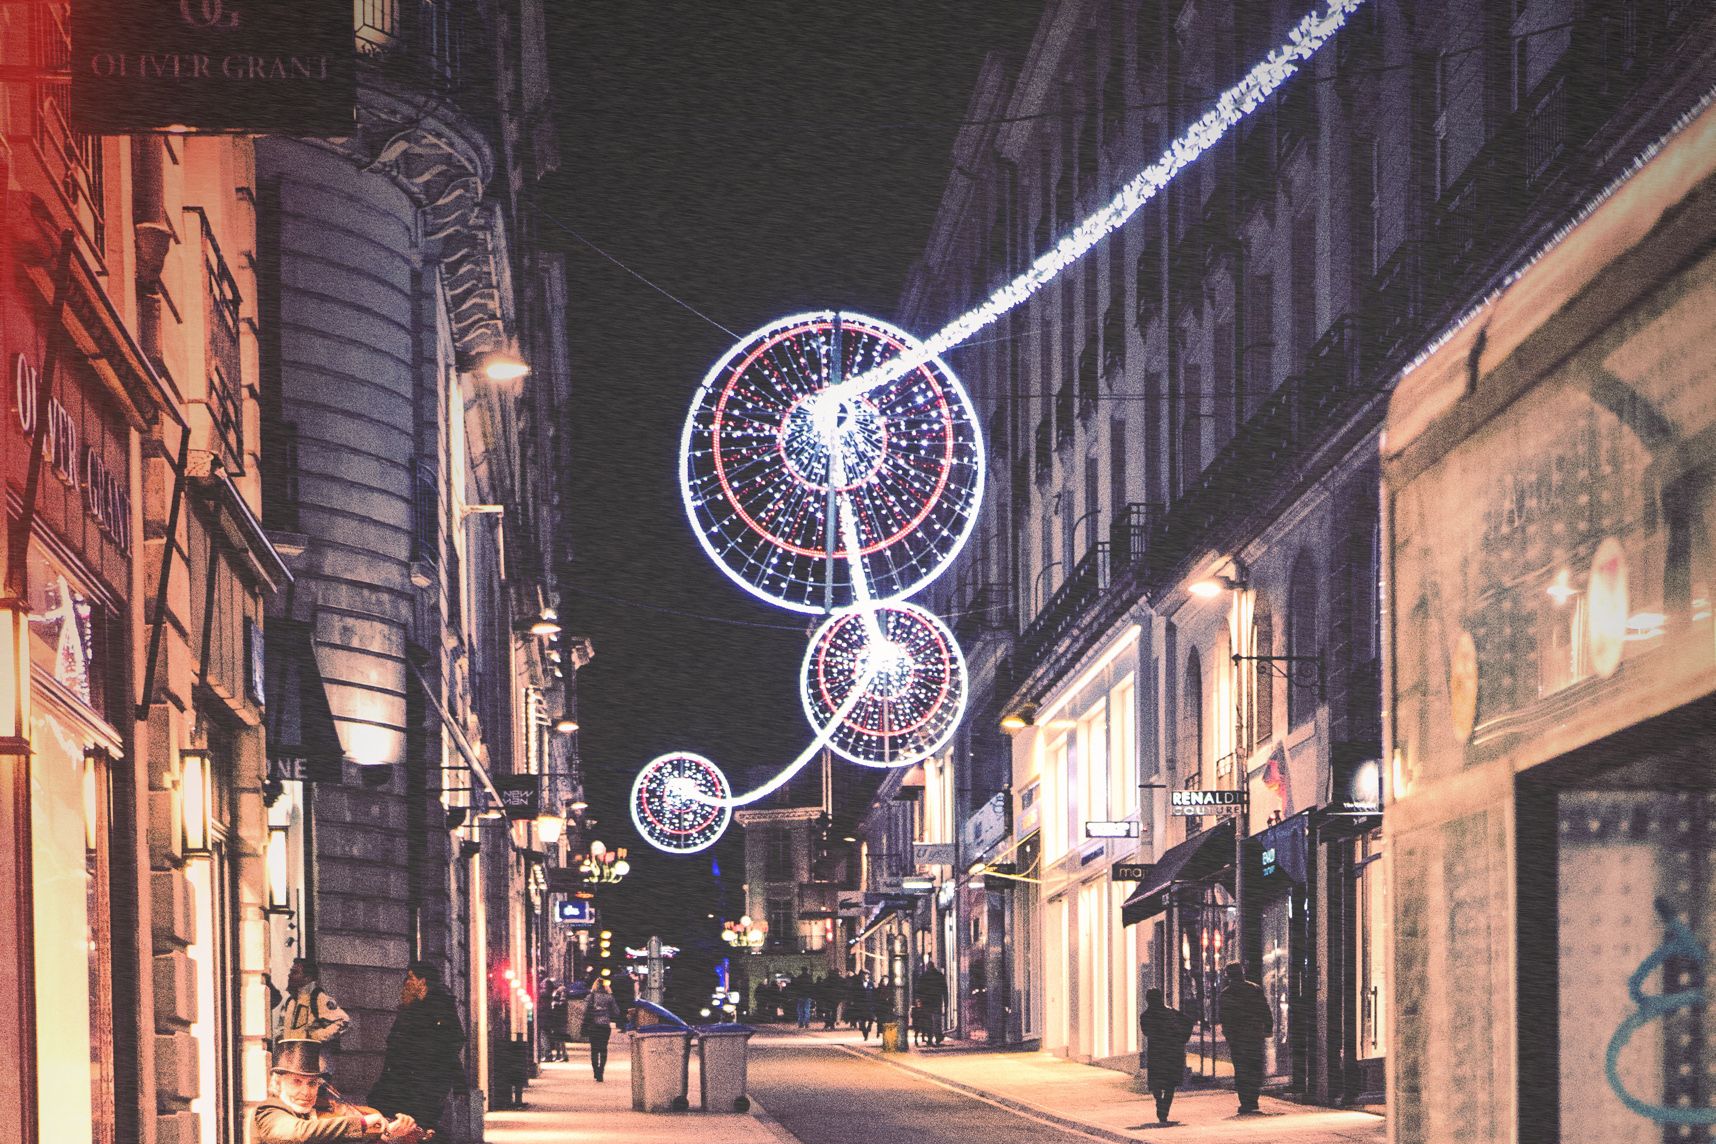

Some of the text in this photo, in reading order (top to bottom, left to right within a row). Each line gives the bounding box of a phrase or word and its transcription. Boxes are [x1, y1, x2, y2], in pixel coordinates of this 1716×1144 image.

[91, 54, 328, 80] OLIVER GRANT
[17, 352, 80, 492] OLVER
[1172, 791, 1240, 806] RENALDI
[1173, 805, 1240, 816] COUTURE
